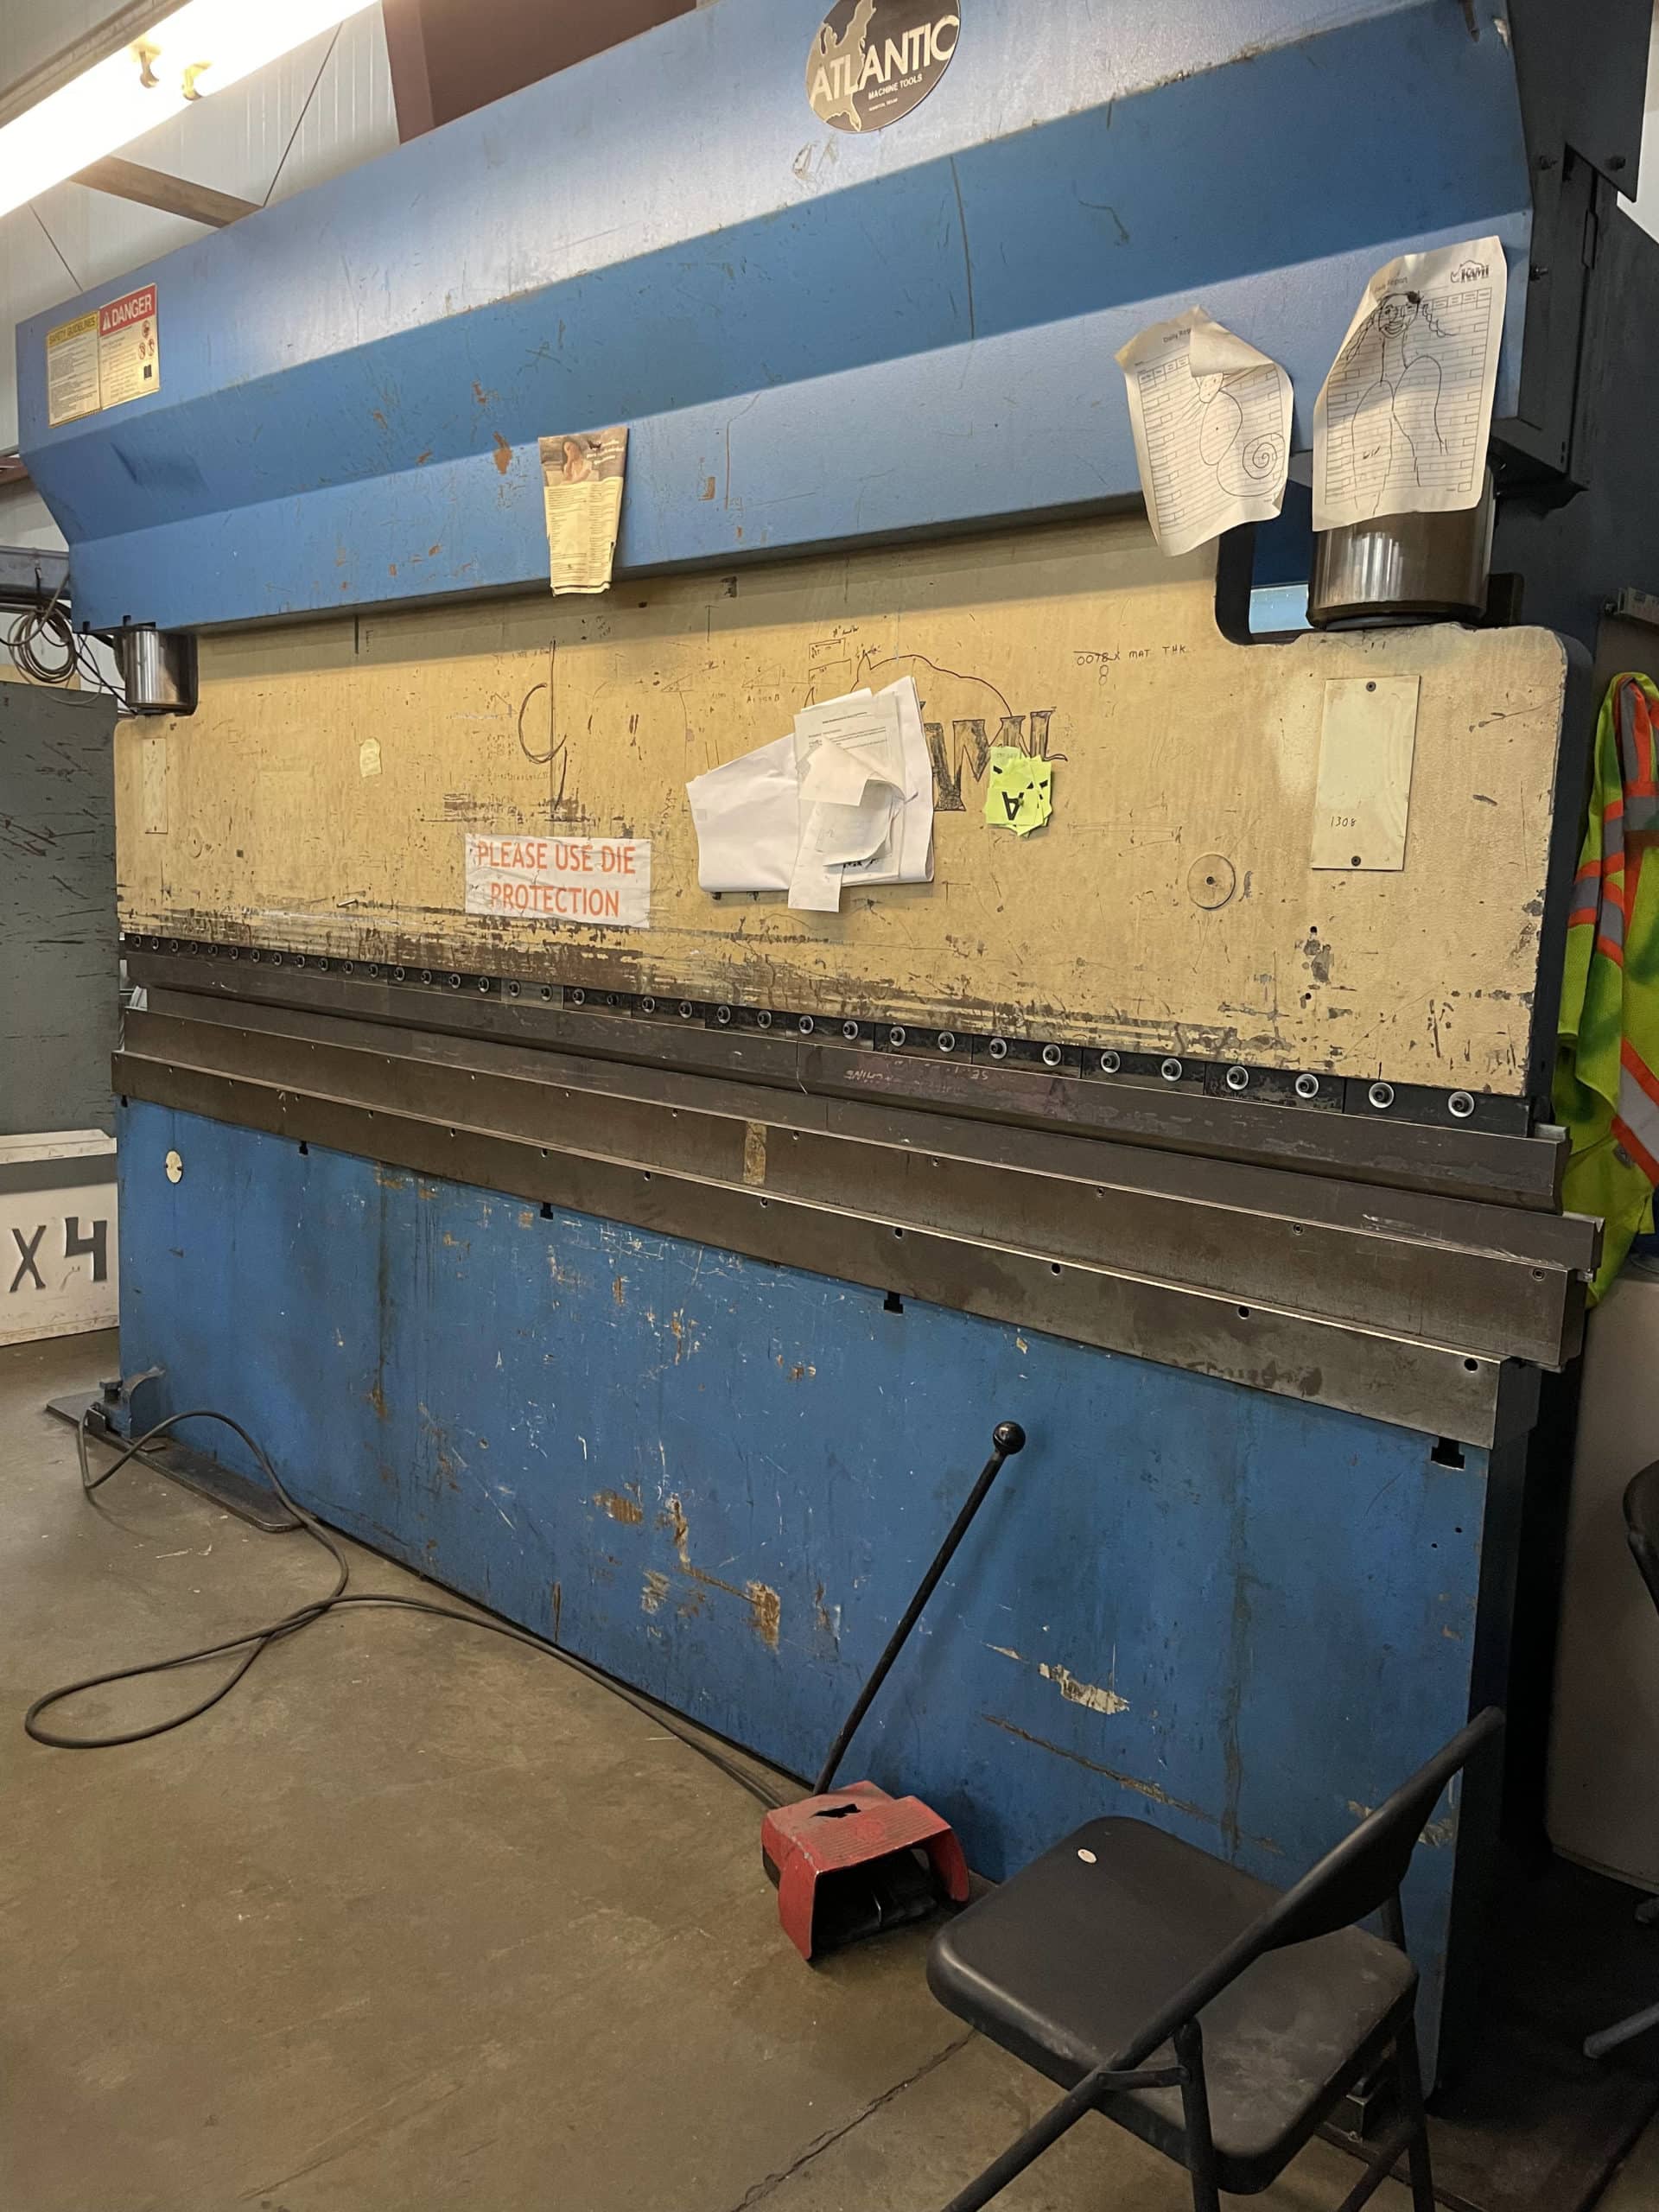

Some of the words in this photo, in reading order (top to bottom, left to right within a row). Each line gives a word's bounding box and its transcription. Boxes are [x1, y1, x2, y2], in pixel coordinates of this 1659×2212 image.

[809, 14, 960, 111] ATLANTIC
[868, 82, 899, 100] MACHINE
[899, 73, 923, 90] TOOLS
[111, 294, 152, 327] DANGER
[49, 327, 67, 346] SAFETY
[67, 316, 96, 338] GUIDELINES
[1330, 816, 1357, 828] 1308
[477, 841, 548, 870] PLEASE
[556, 844, 594, 873] USE
[601, 846, 636, 874] DIE
[490, 882, 620, 918] PROTECTION
